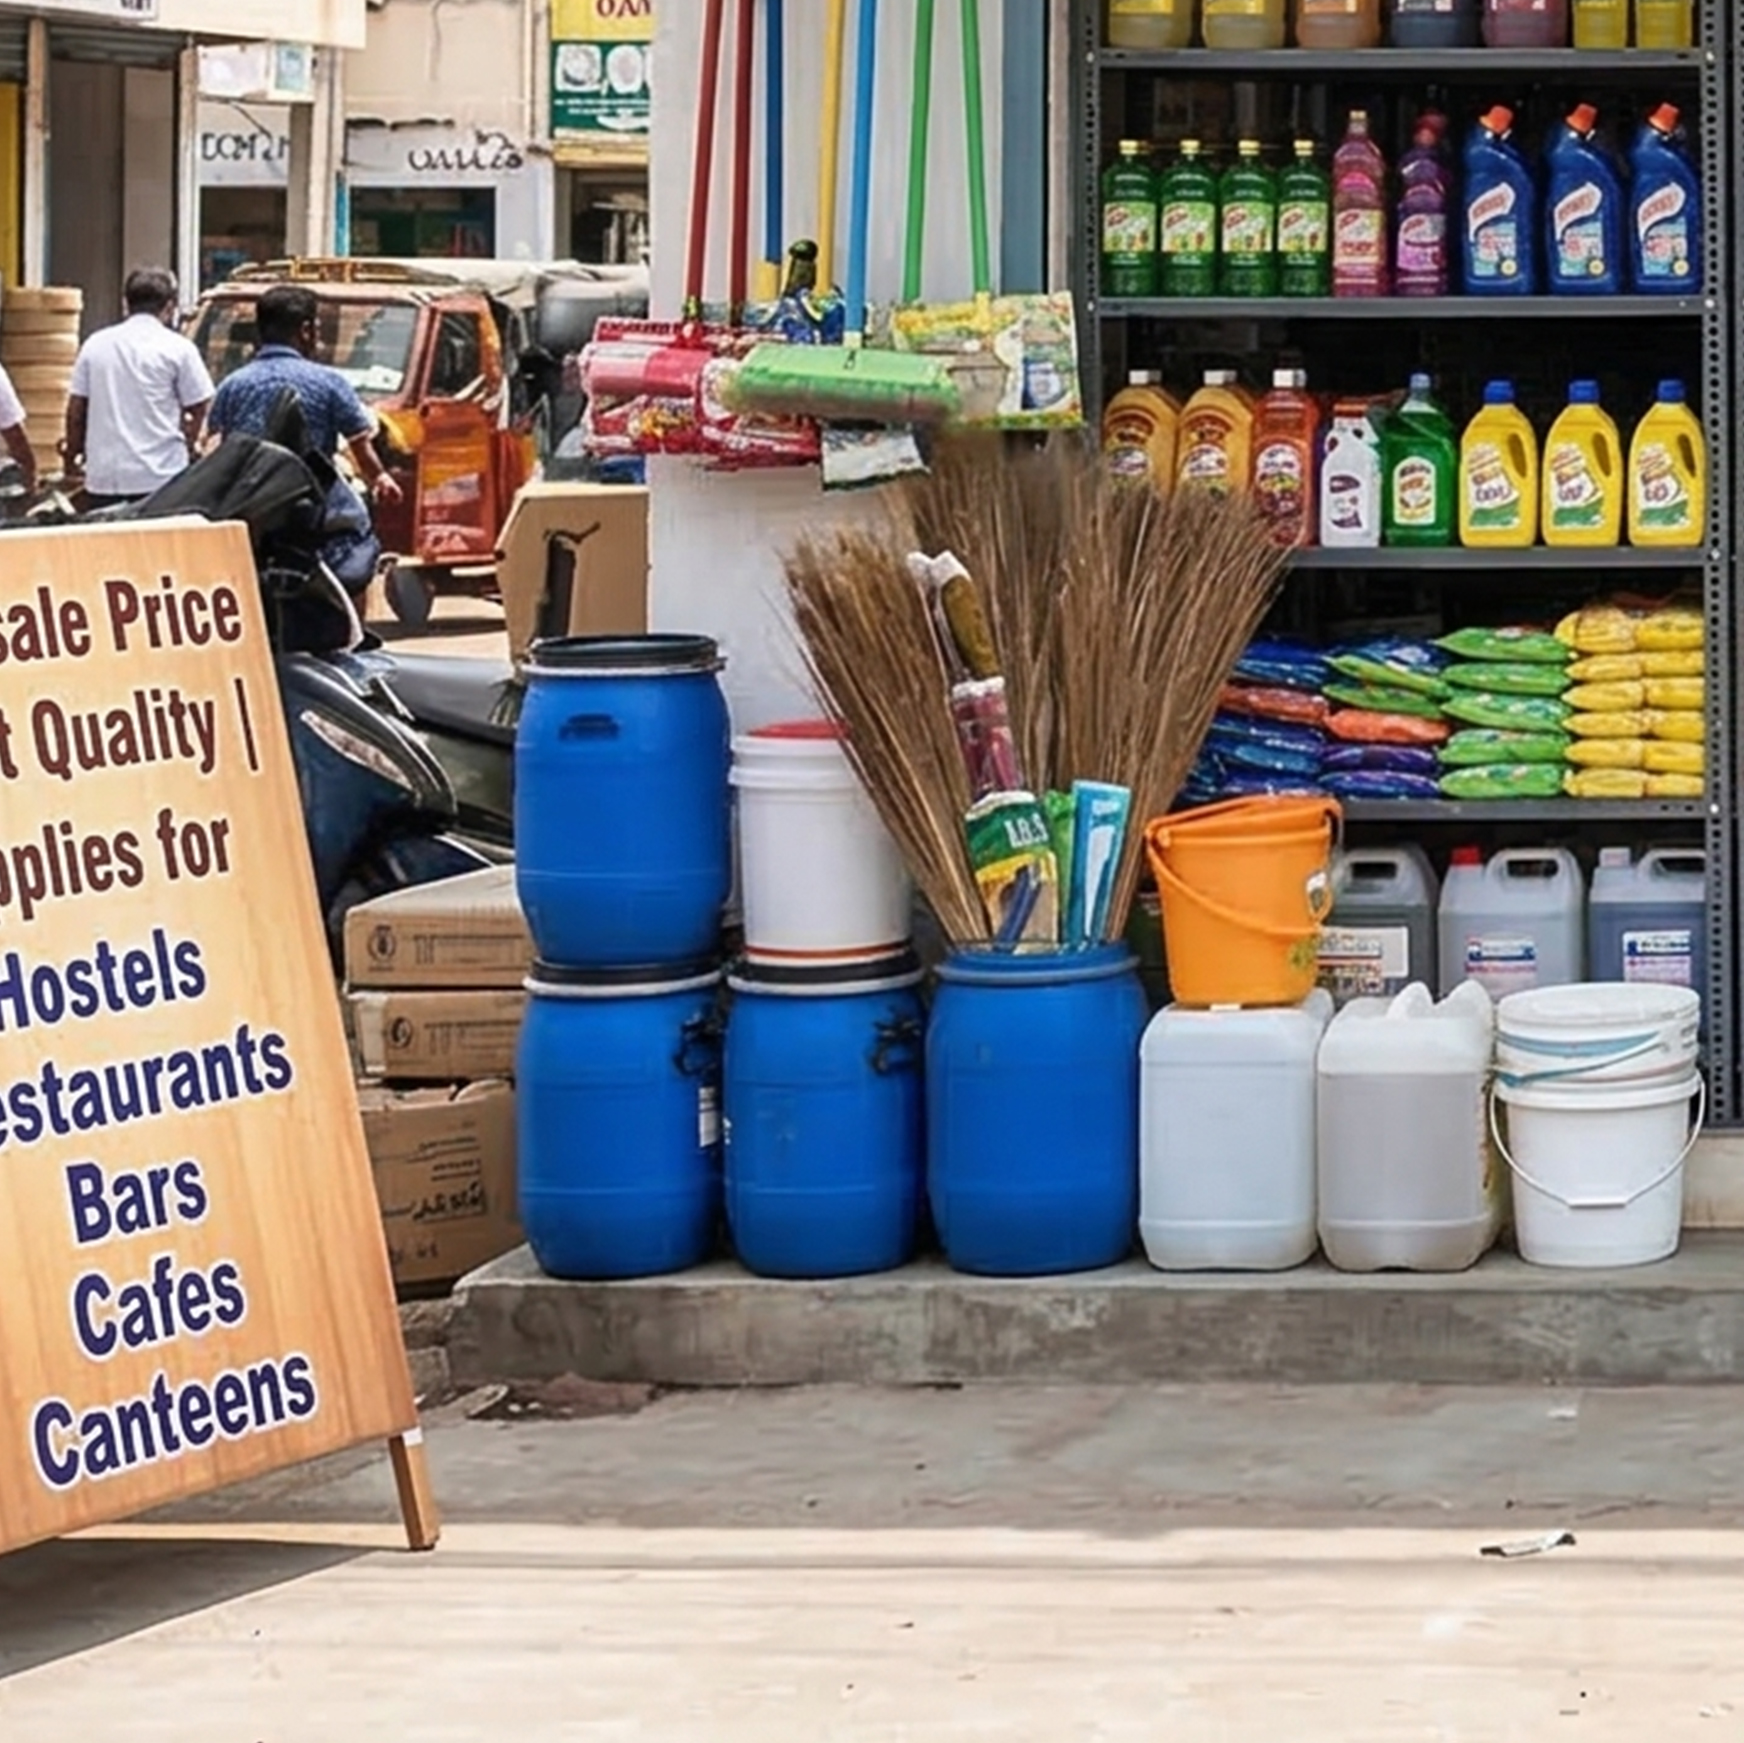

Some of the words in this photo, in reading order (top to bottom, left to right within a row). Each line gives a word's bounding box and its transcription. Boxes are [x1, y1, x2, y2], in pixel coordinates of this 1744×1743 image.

[104, 576, 241, 652] Price
[32, 688, 214, 781] Quality
[157, 807, 229, 881] for
[0, 927, 206, 1030] Hostels
[0, 1024, 292, 1144] staurants
[66, 1161, 207, 1244] Bars
[74, 1256, 245, 1356] Cafes
[34, 1355, 316, 1486] Canteens
